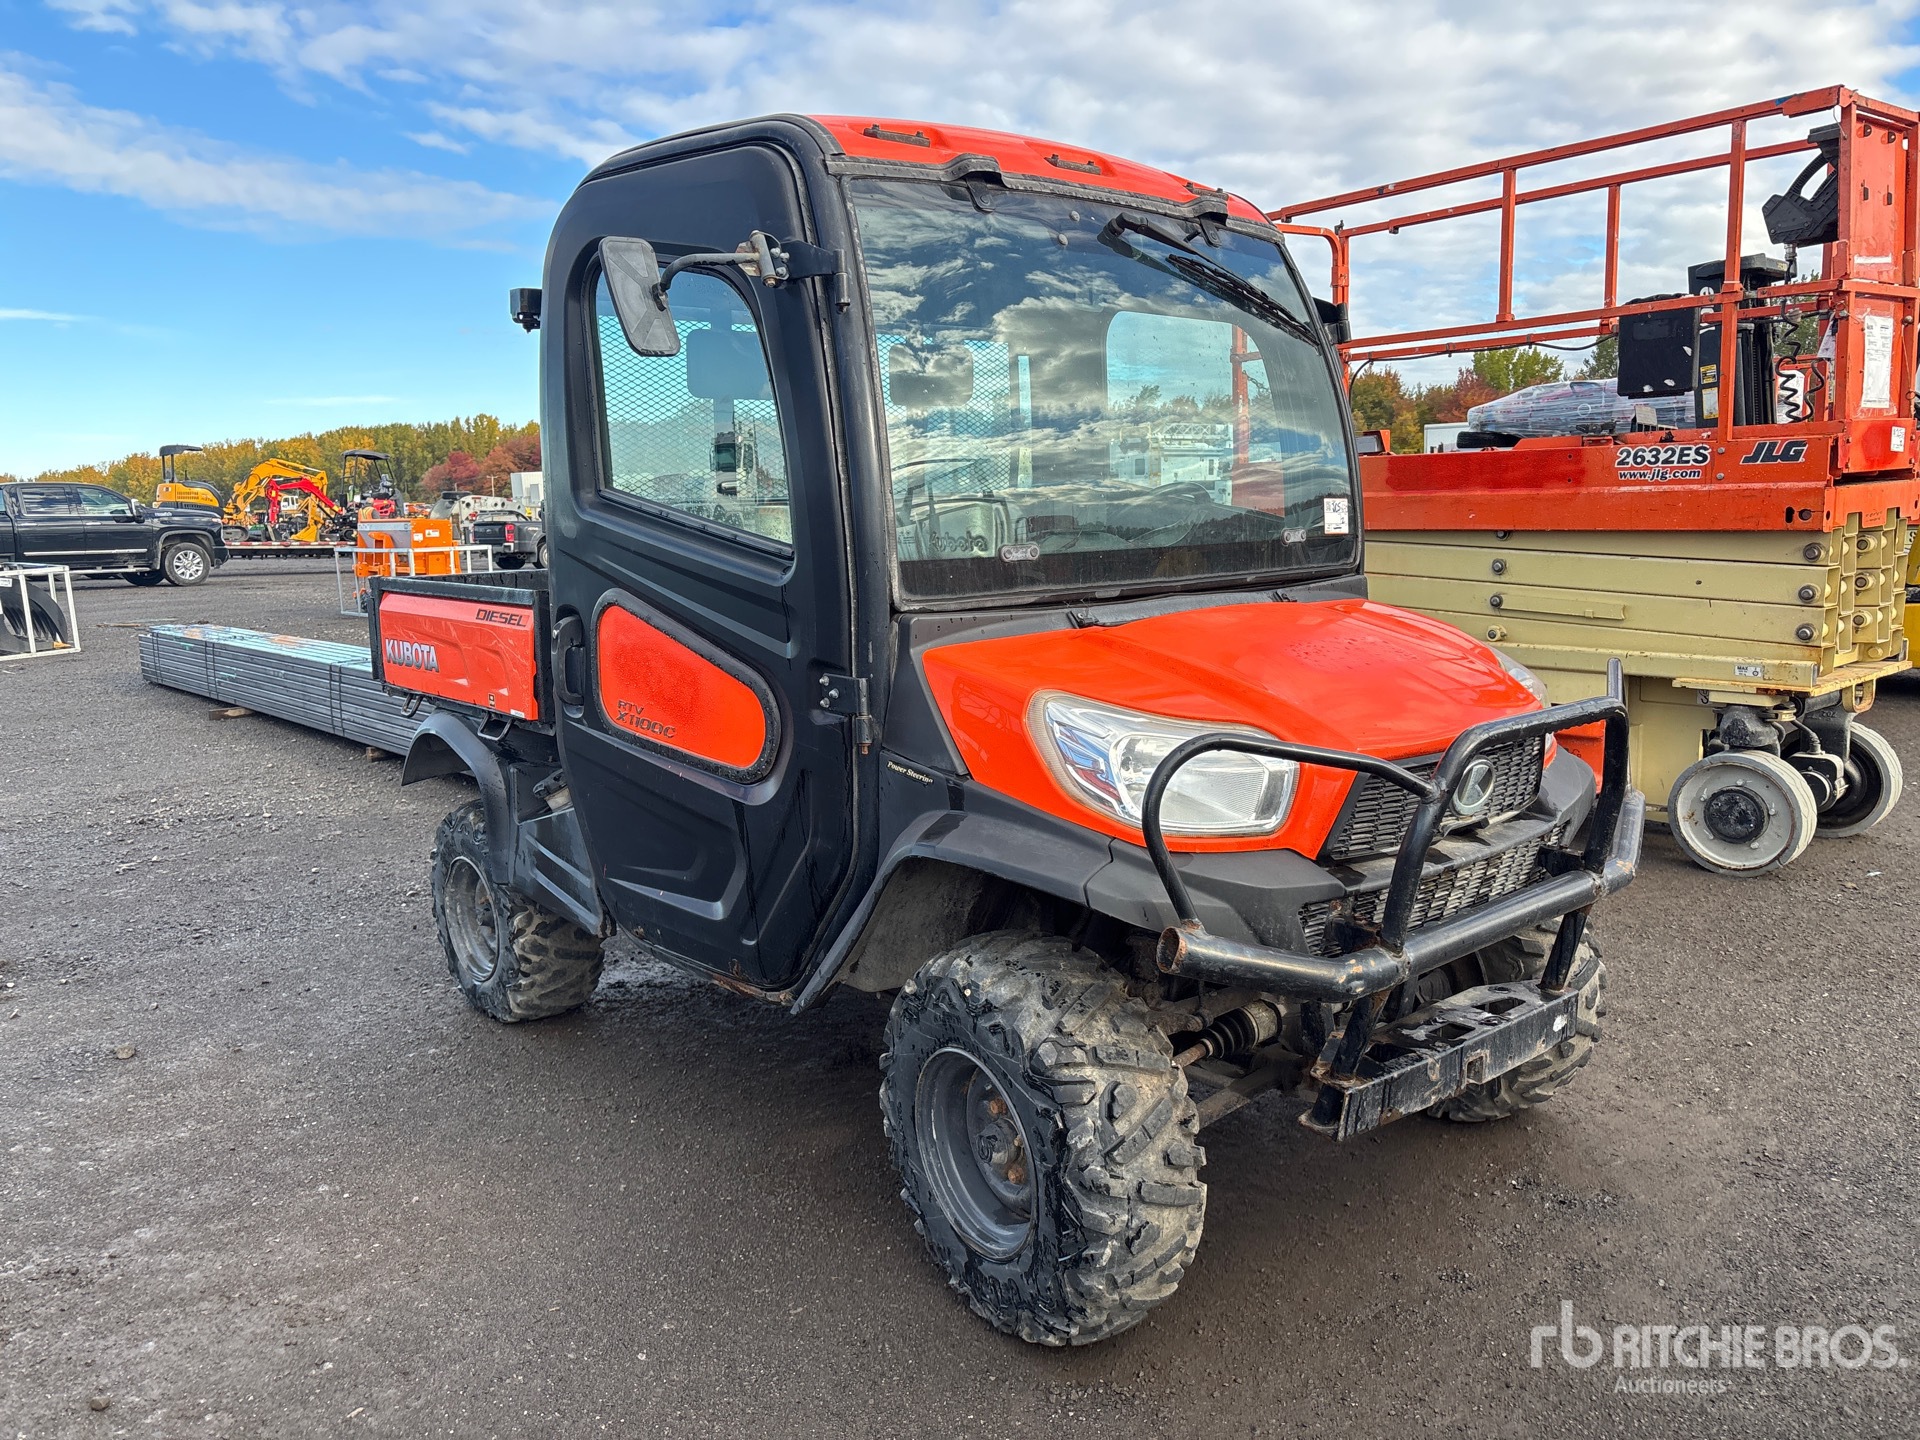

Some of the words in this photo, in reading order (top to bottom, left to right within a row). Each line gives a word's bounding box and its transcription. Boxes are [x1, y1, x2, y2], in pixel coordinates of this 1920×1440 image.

[1616, 445, 1710, 466] 2632ES
[1740, 441, 1807, 463] JLG
[1618, 469, 1701, 481] www.jlg.com
[475, 608, 527, 627] DIESEL
[385, 638, 440, 672] KUBOTA
[617, 700, 644, 715] RTV
[616, 709, 676, 738] X1100C
[887, 760, 907, 773] Power
